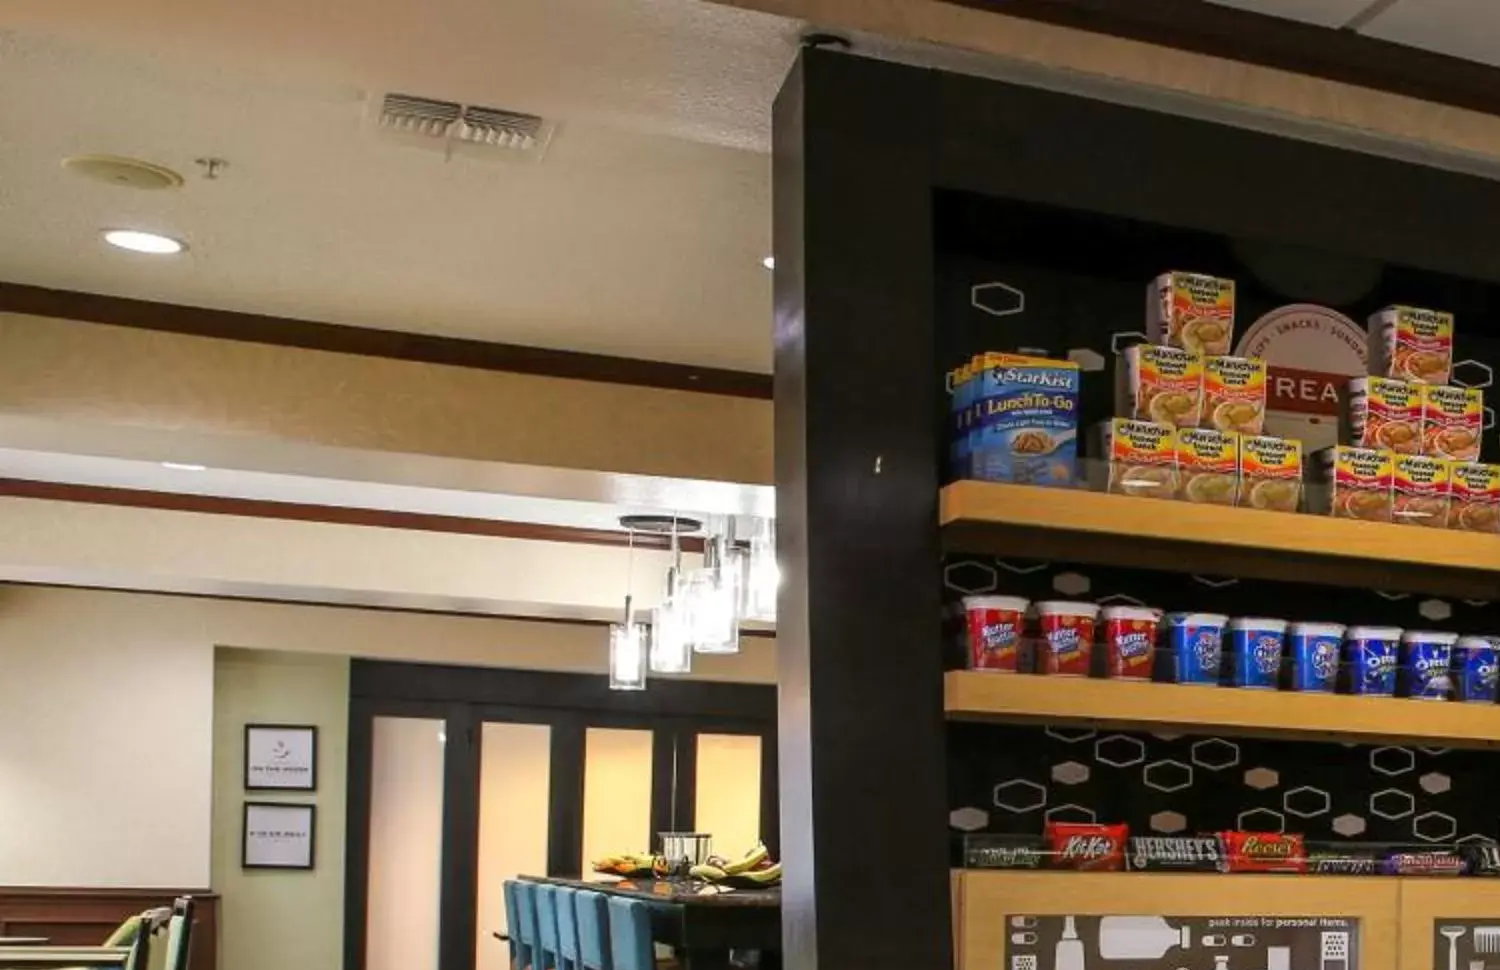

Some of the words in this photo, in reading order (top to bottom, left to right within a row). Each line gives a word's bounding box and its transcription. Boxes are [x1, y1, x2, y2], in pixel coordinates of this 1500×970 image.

[1006, 367, 1073, 389] StarKist
[987, 392, 1032, 415] Lunch
[1134, 837, 1217, 861] HERSHEY'S
